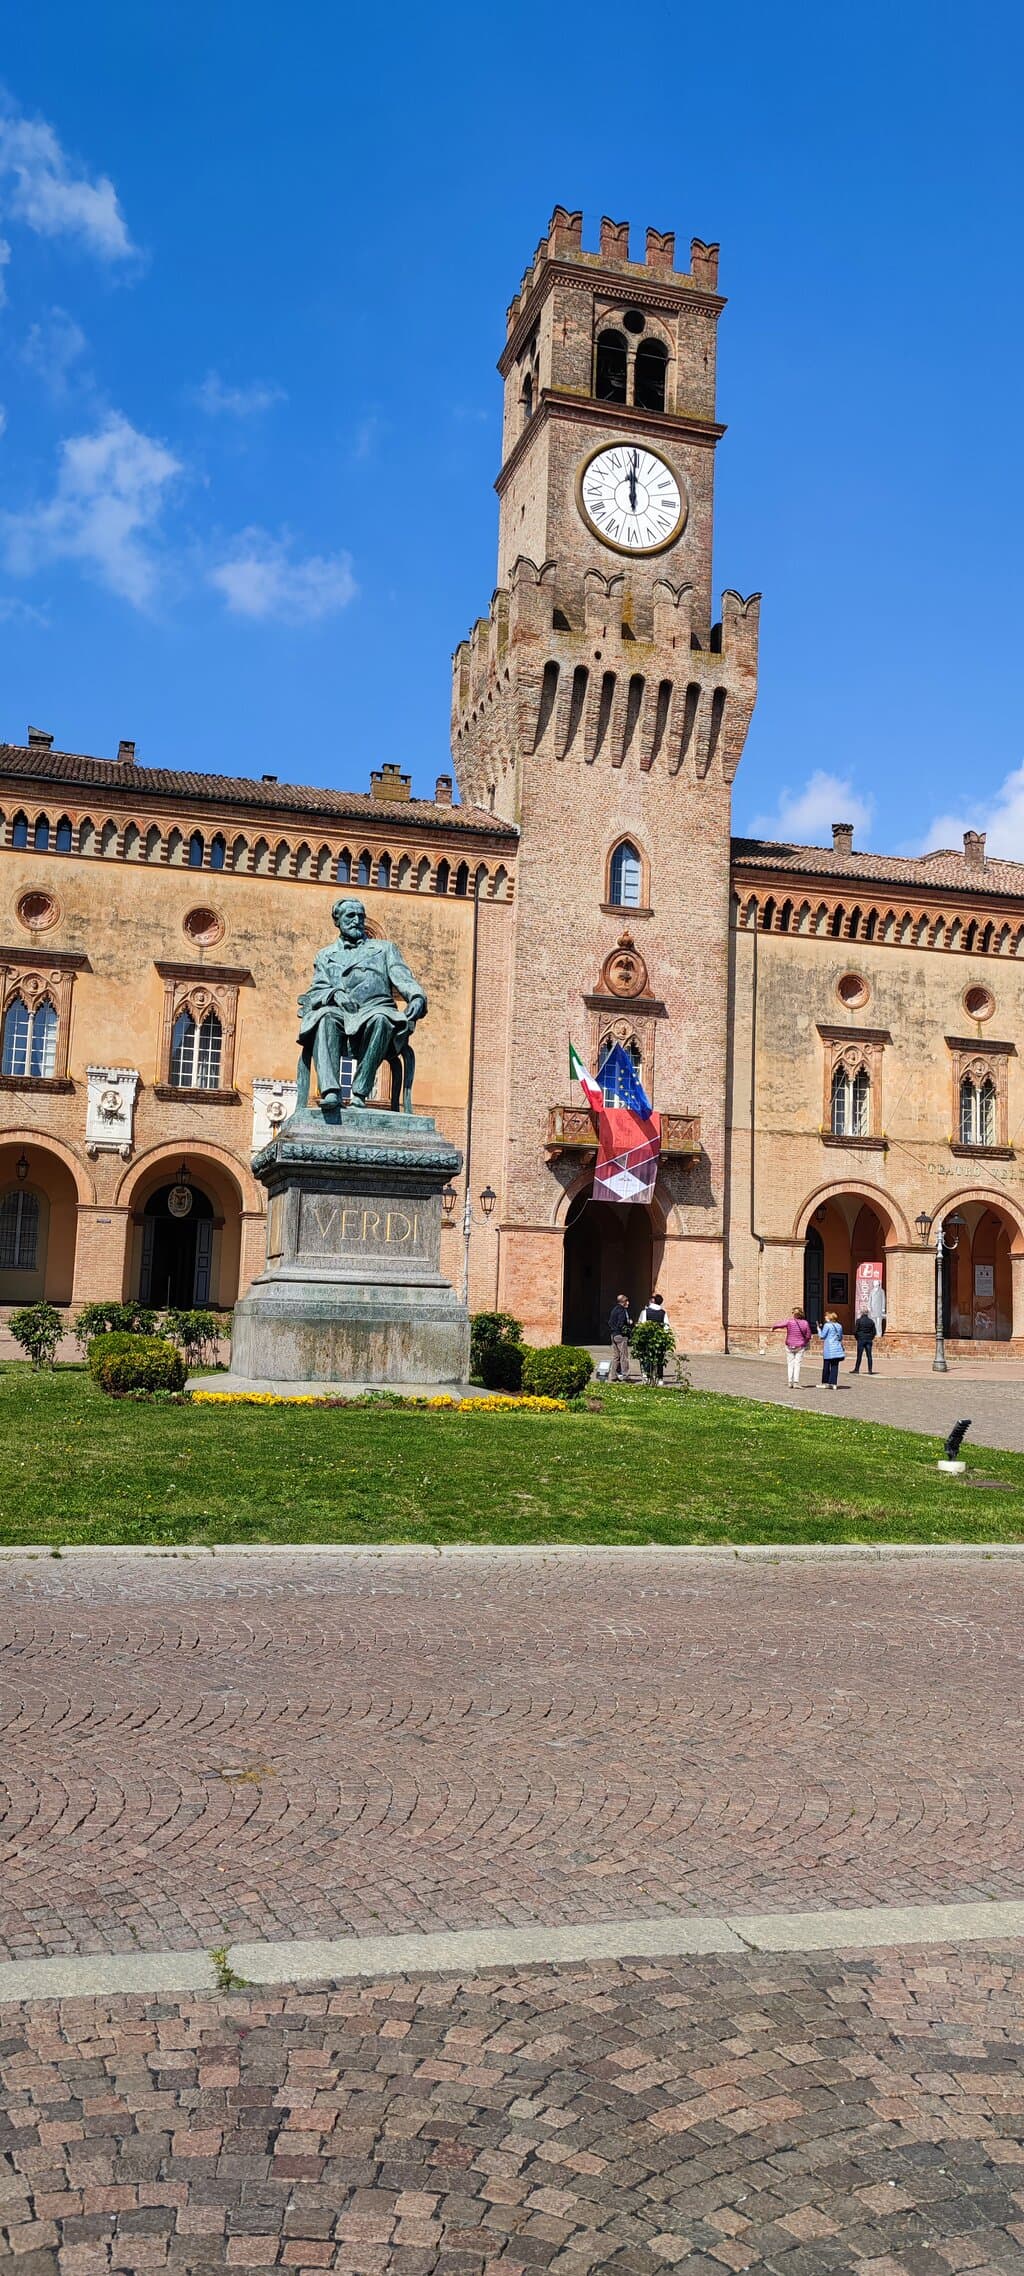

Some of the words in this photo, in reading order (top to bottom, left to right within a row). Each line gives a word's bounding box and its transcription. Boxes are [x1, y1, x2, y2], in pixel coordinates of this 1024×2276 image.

[606, 452, 623, 471] XI
[592, 464, 609, 481] X
[587, 482, 603, 497] IX
[657, 480, 672, 489] II
[590, 501, 607, 521] VIII
[661, 499, 676, 508] III
[605, 518, 620, 538] VII
[657, 514, 672, 533] IV
[627, 527, 638, 544] VI
[646, 527, 657, 542] V
[927, 1163, 982, 1177] TEATRO
[312, 1208, 419, 1243] VERDI
